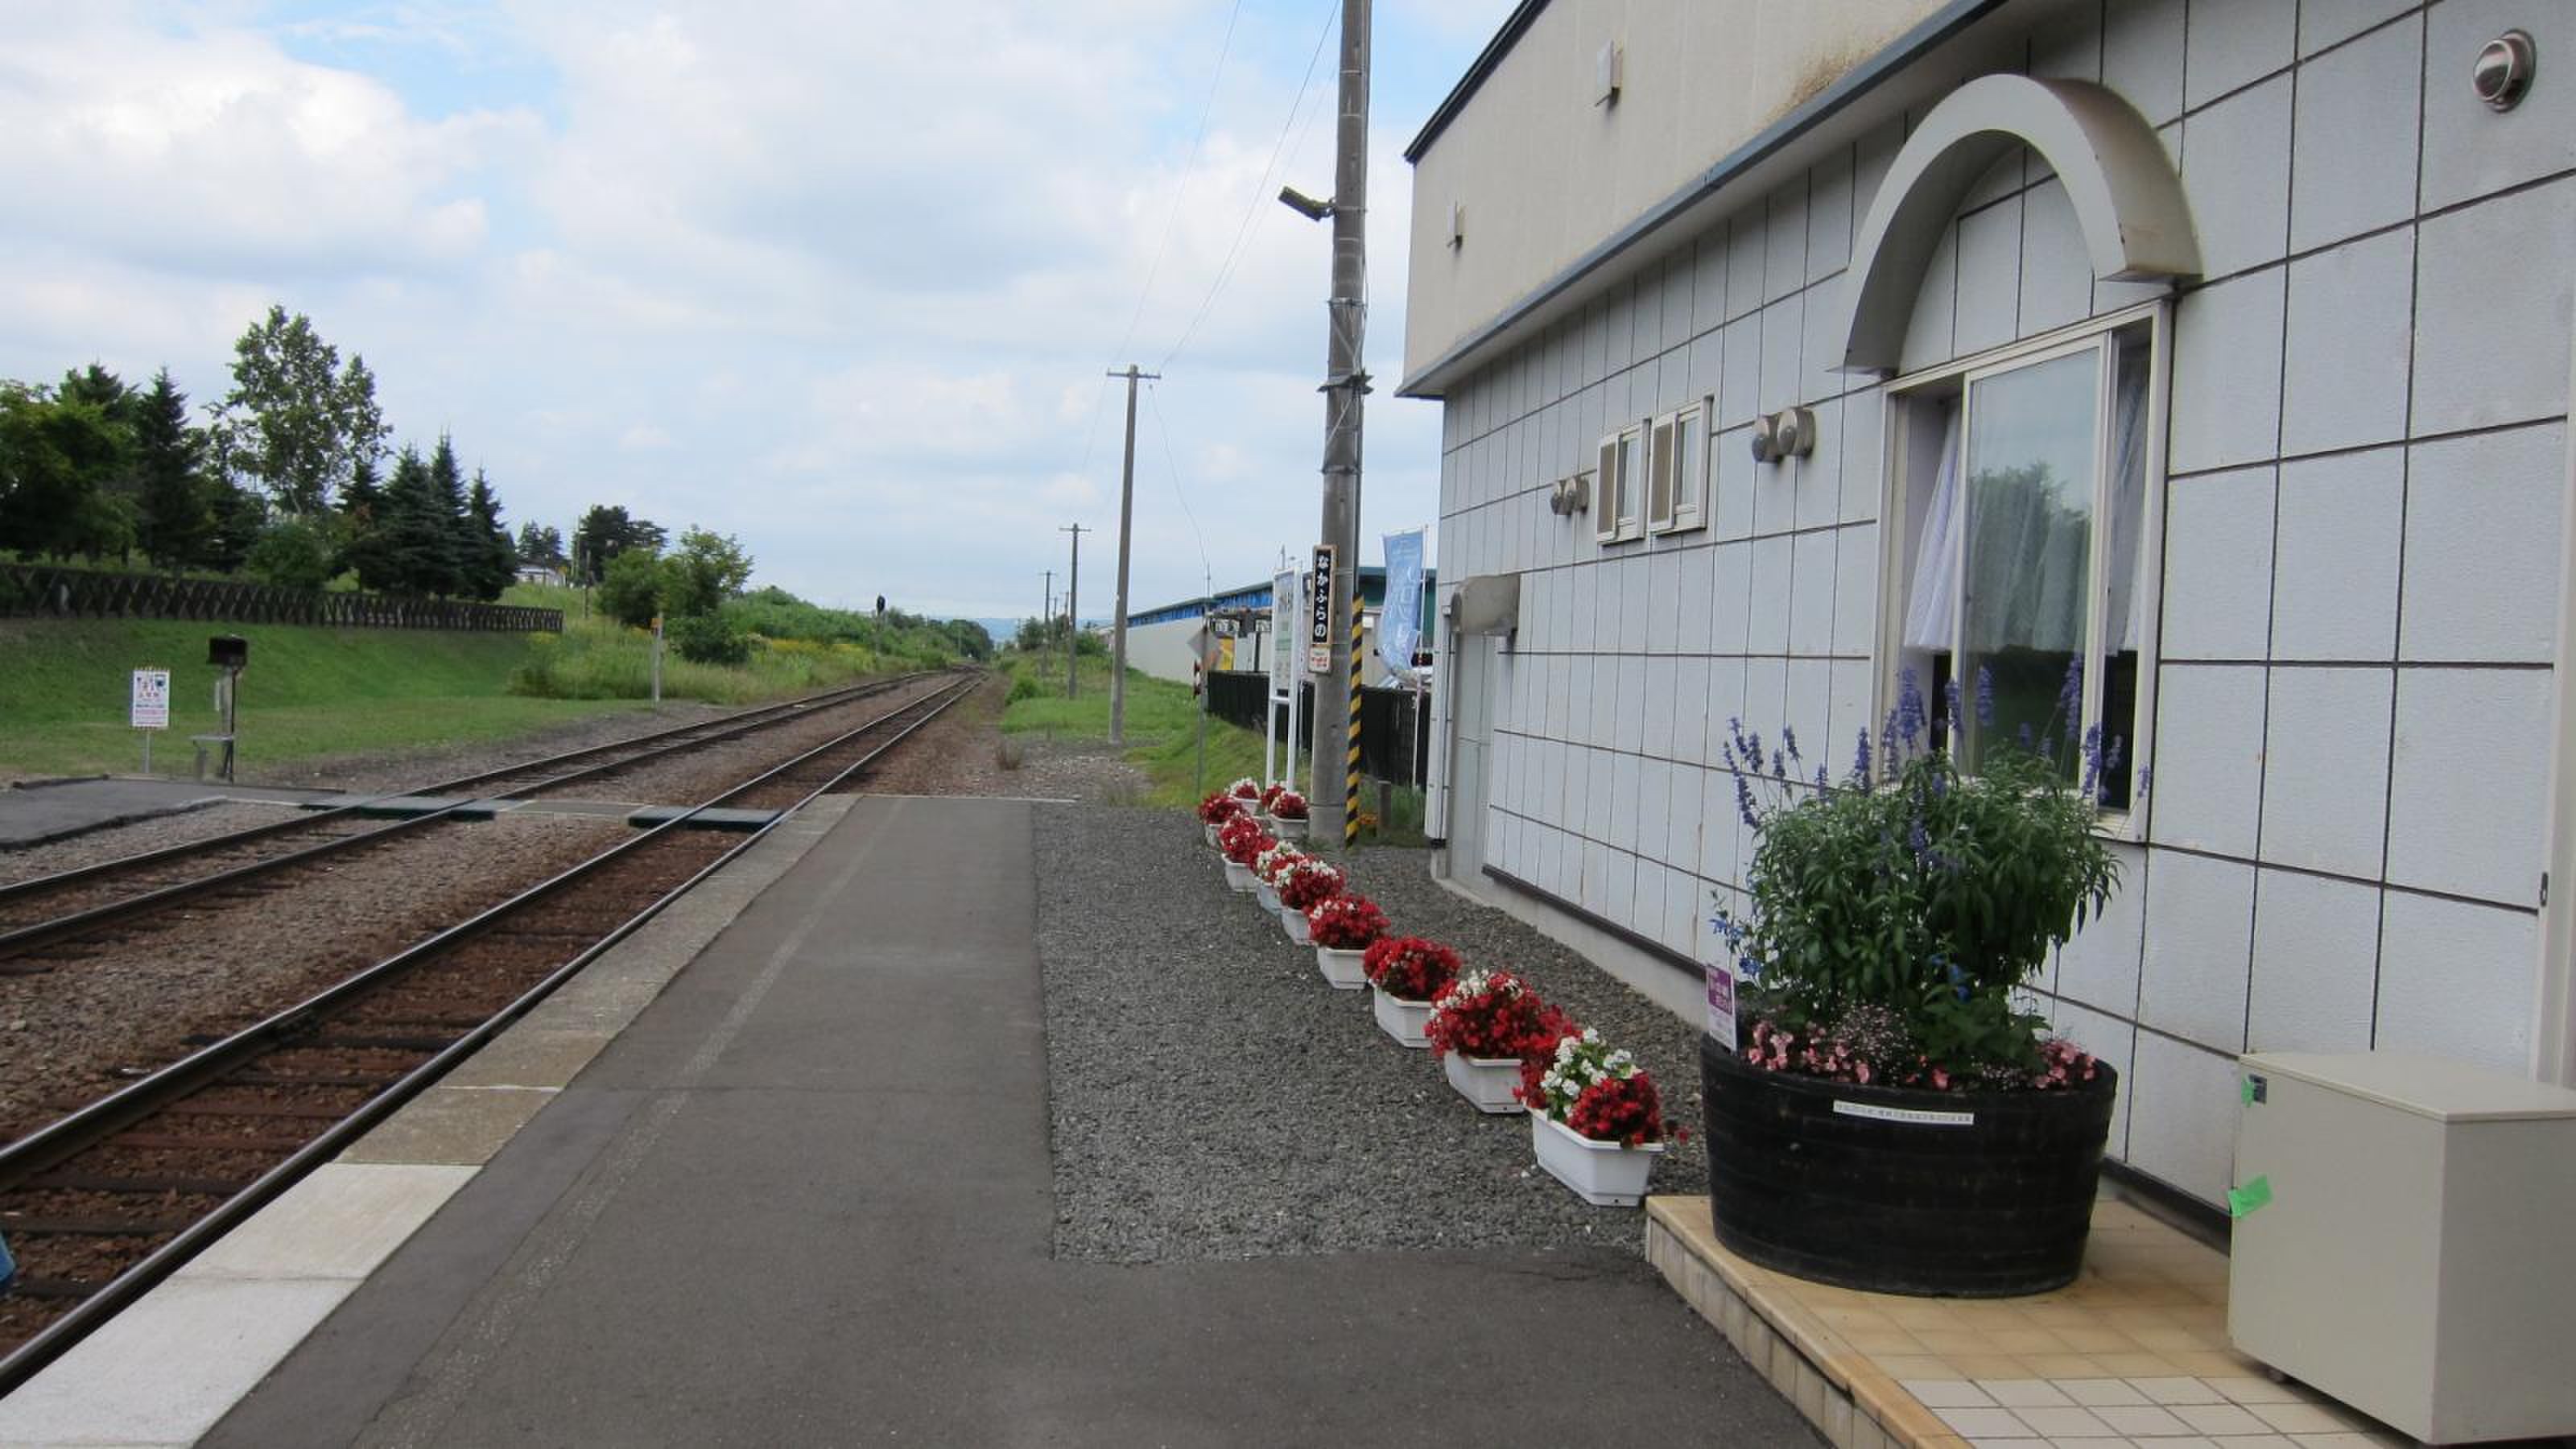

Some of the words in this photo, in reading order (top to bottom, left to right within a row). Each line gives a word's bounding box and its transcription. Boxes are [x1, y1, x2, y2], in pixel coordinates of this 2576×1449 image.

[1314, 555, 1328, 638] なかふらの
